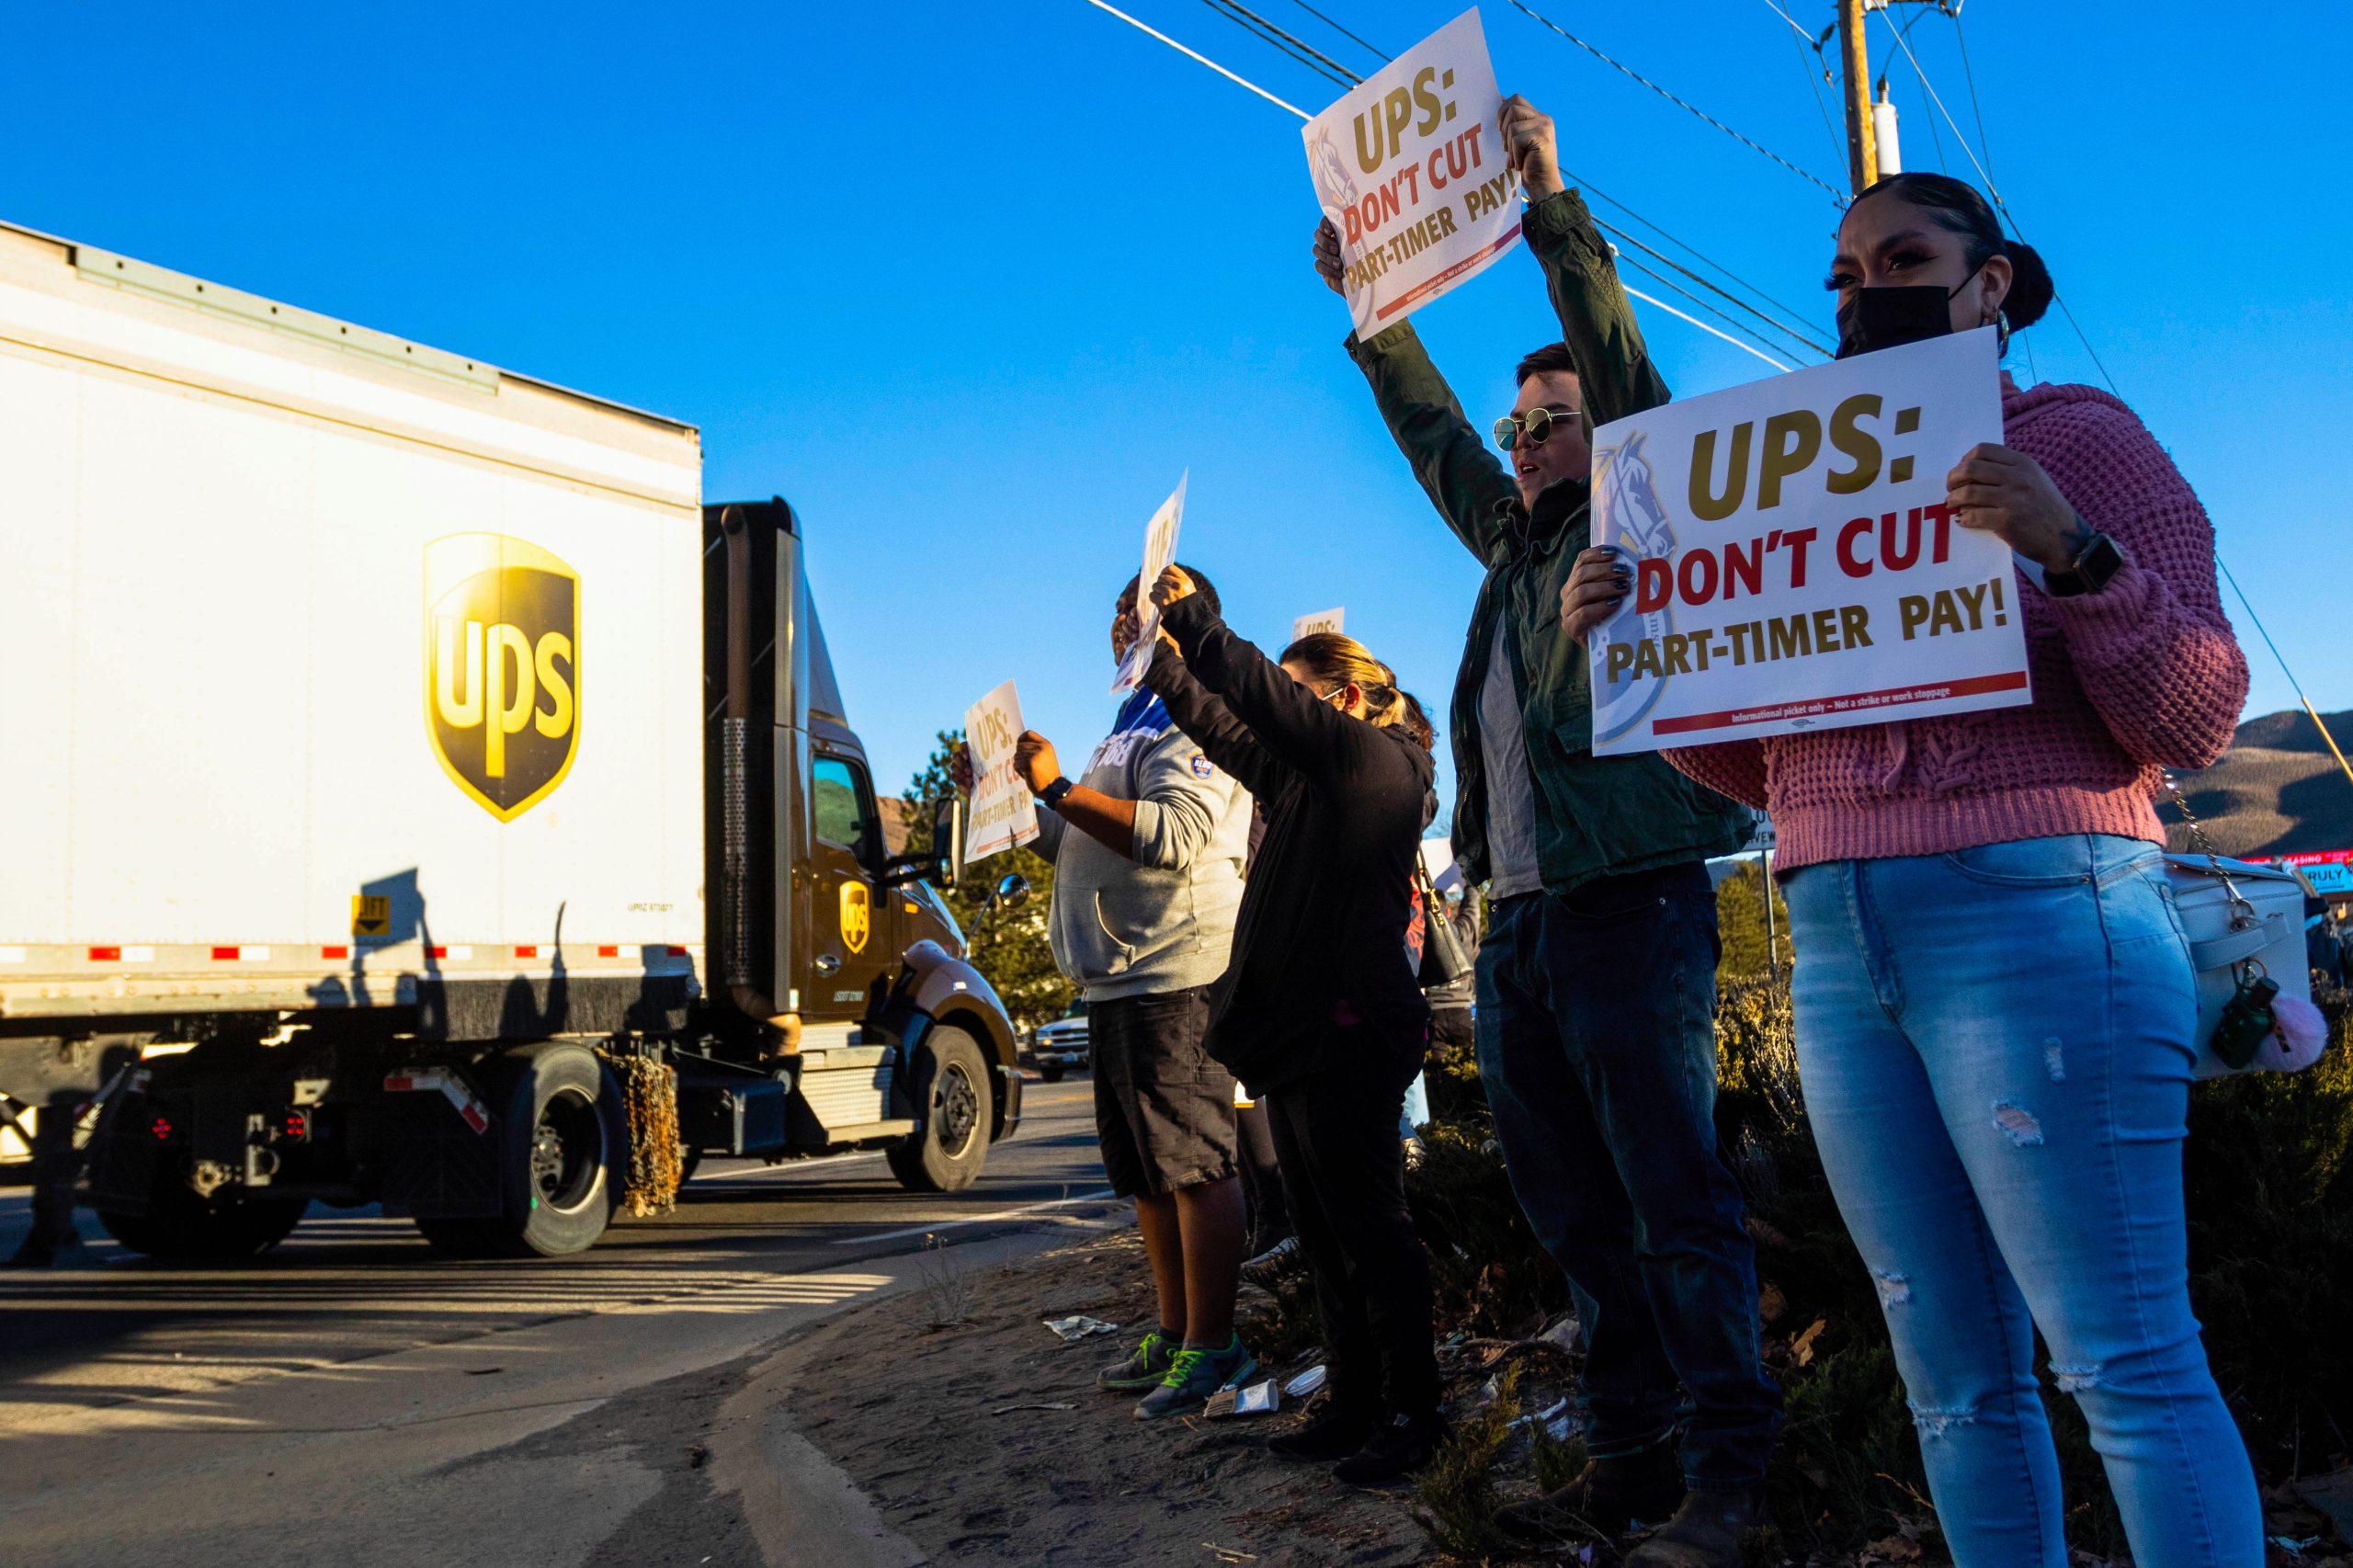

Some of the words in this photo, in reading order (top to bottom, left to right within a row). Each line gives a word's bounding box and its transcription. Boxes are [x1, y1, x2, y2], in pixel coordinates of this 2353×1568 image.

[1353, 66, 1457, 175] UPS:
[1343, 161, 1419, 246] DON'T
[1427, 122, 1482, 190] CUT
[1346, 206, 1458, 295] PART-TIMER
[1463, 167, 1518, 222] PAY!
[1688, 392, 1922, 521] UPS:
[1635, 527, 1817, 615] DON'T
[1836, 502, 1959, 579] CUT
[1606, 605, 1874, 684] PART-TIMER
[1898, 577, 2007, 641] PAY!
[436, 617, 573, 778] ups
[976, 707, 1012, 761] UPS:
[1732, 707, 1782, 723] Informational
[1783, 702, 1807, 718] picket
[1808, 702, 1825, 714] only
[1834, 699, 1849, 710] Not
[1850, 699, 1857, 708] a
[1857, 695, 1881, 707] strike
[1881, 695, 1891, 703] or
[1892, 690, 1913, 702] work
[1914, 687, 1951, 701] stoppage
[971, 796, 1017, 832] PART-TIMER
[978, 764, 1004, 801] DON'T
[358, 897, 385, 917] LIFT
[2306, 869, 2343, 881] RULY
[843, 903, 866, 942] ups
